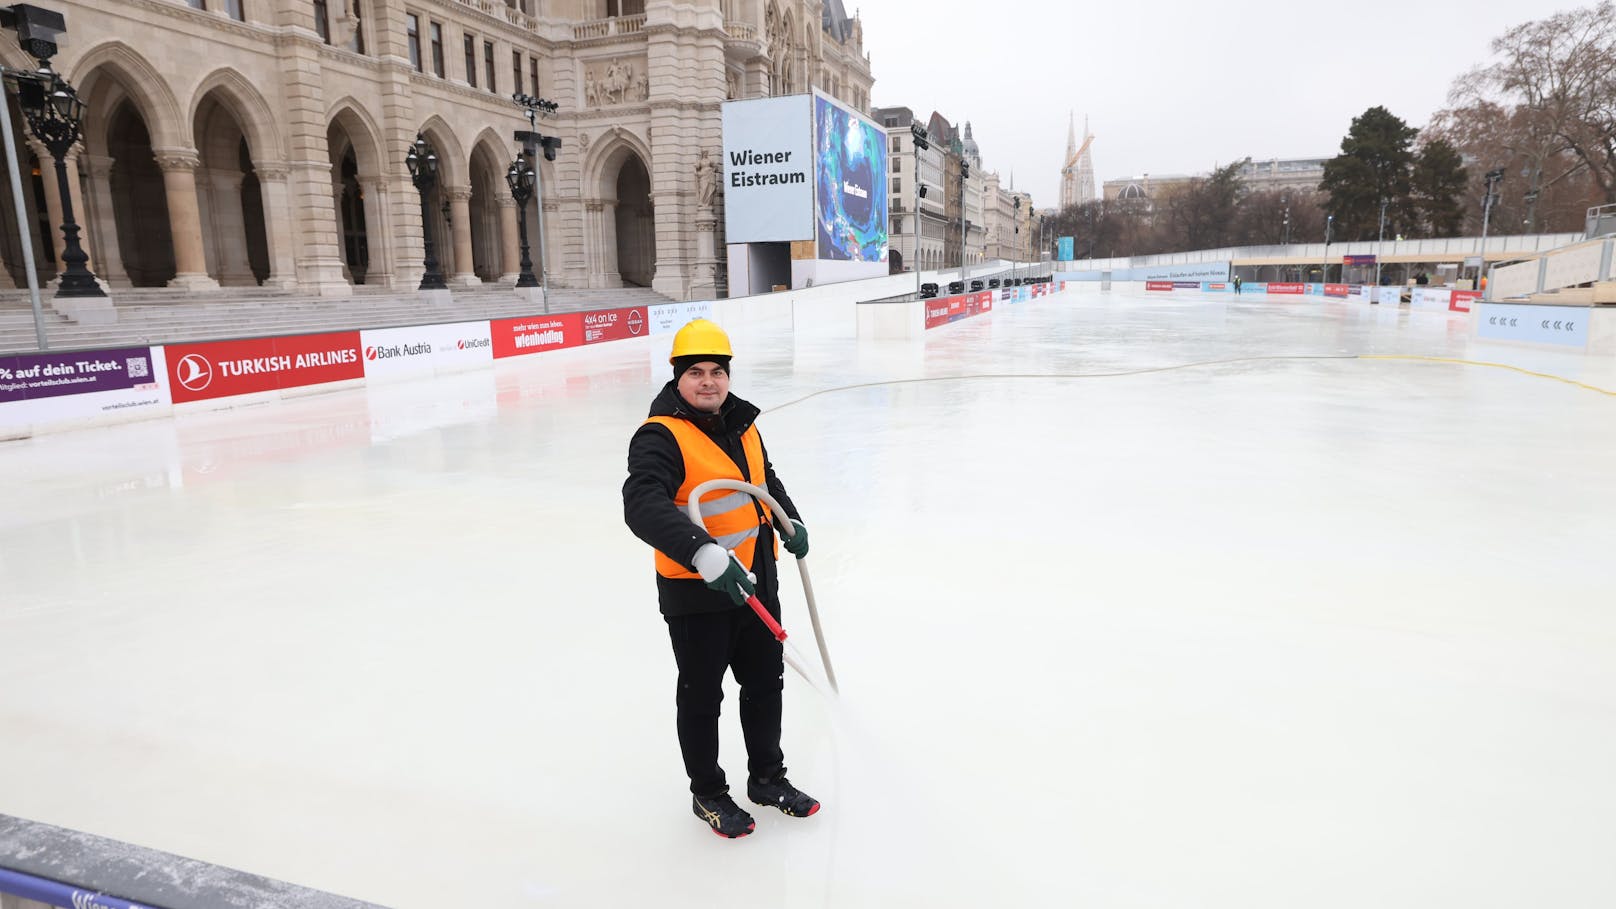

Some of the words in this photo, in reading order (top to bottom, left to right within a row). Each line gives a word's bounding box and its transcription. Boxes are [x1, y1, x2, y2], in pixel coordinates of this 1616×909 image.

[730, 150, 792, 166] Wiener
[731, 172, 805, 187] Eistraum
[585, 313, 597, 325] 4x4
[598, 314, 607, 323] on
[513, 323, 527, 332] mehr
[464, 338, 490, 349] UniCredit
[378, 346, 402, 359] Bank
[403, 342, 432, 356] Austria
[218, 355, 292, 377] TURKISH
[295, 348, 358, 369] AIRLINES
[15, 365, 40, 379] auf
[43, 362, 75, 376] dein
[76, 360, 122, 374] Ticket.
[29, 376, 97, 388] vorteilsclub.wien.at
[102, 399, 159, 411] vorteilsclub.wien.at
